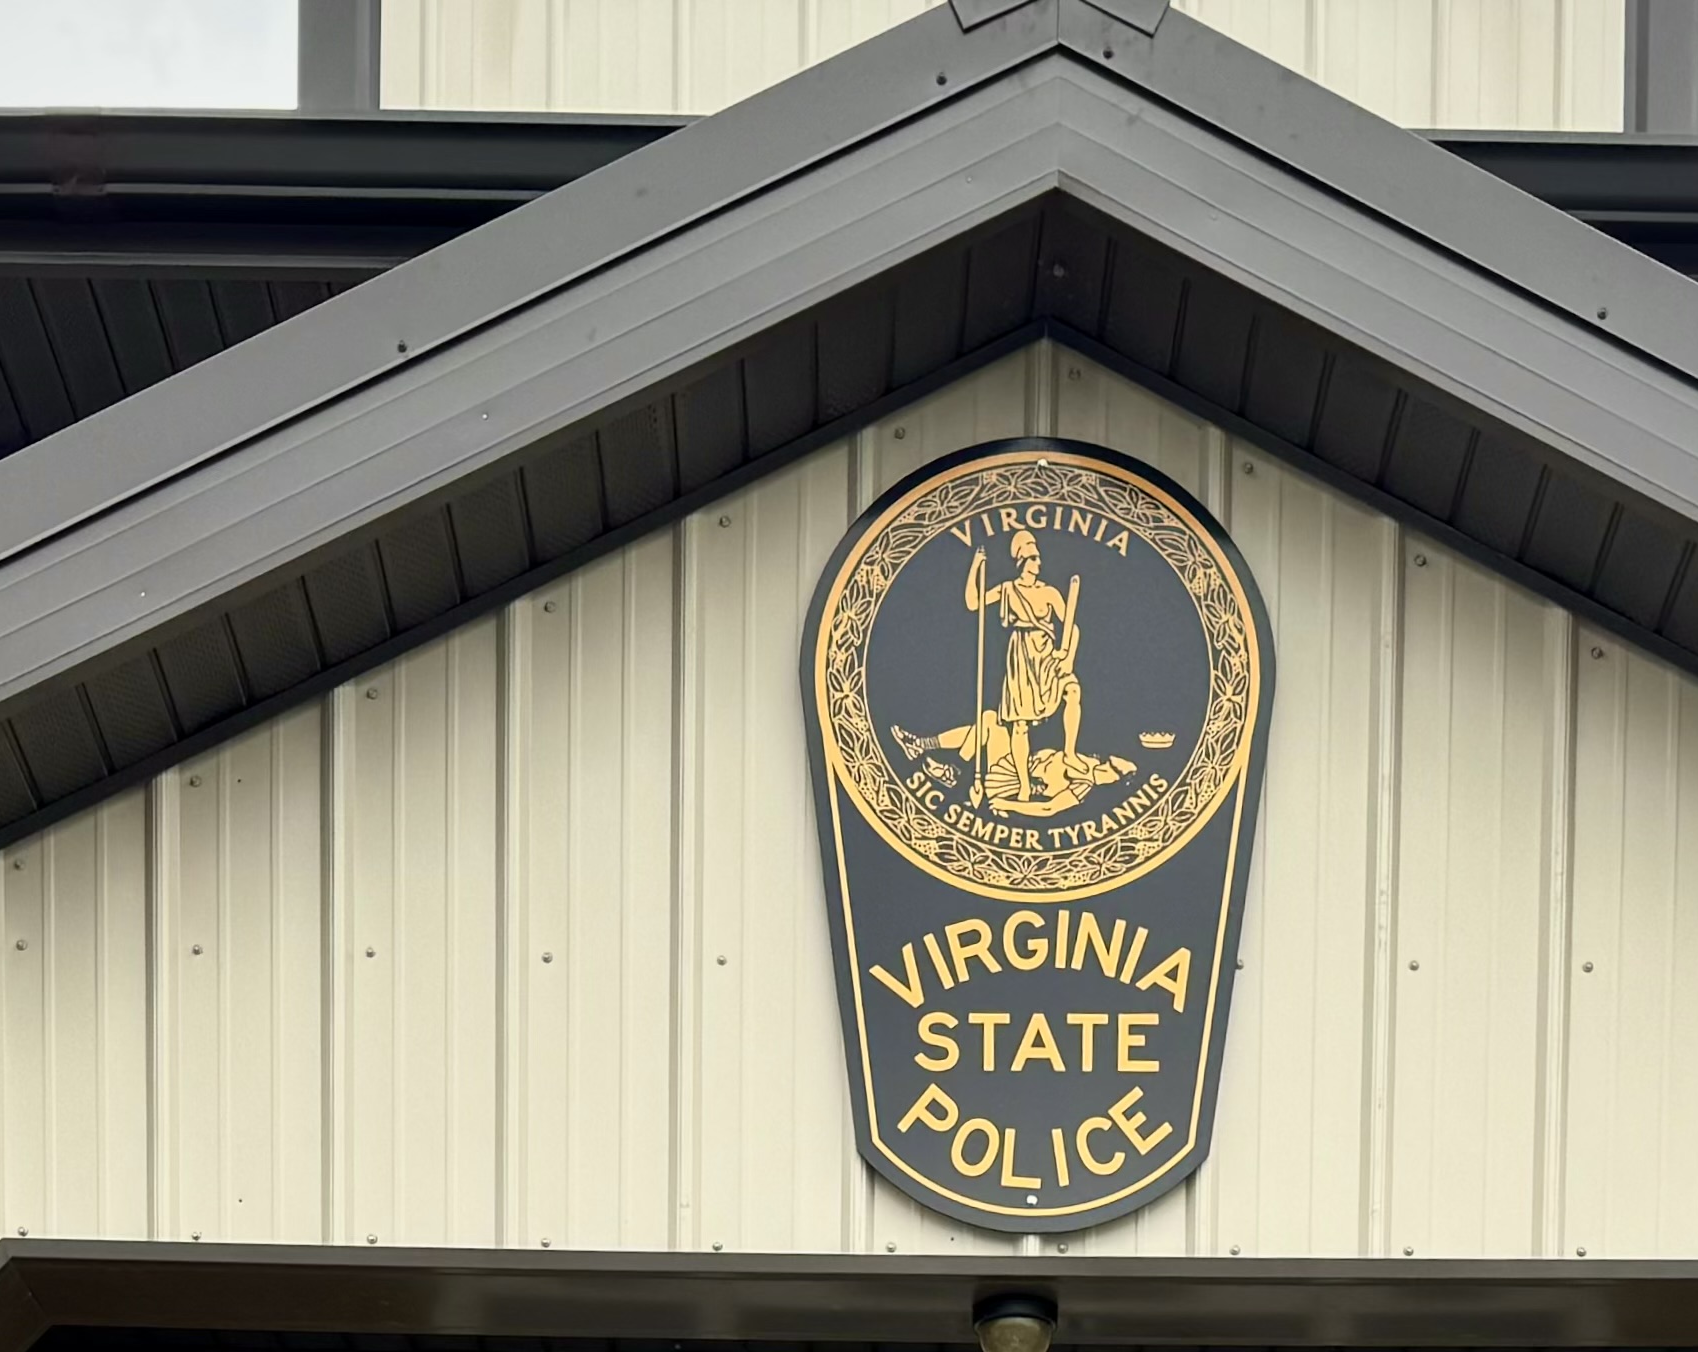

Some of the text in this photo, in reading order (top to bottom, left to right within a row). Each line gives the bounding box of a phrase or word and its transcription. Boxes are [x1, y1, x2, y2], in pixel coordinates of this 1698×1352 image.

[951, 505, 1129, 556] VIRGINIA
[905, 771, 1169, 850] SIC SEMPER TYRANNIS
[869, 910, 1191, 1014] VIRGINIA
[914, 1011, 1160, 1072] STATE
[897, 1082, 1173, 1189] POLICE
